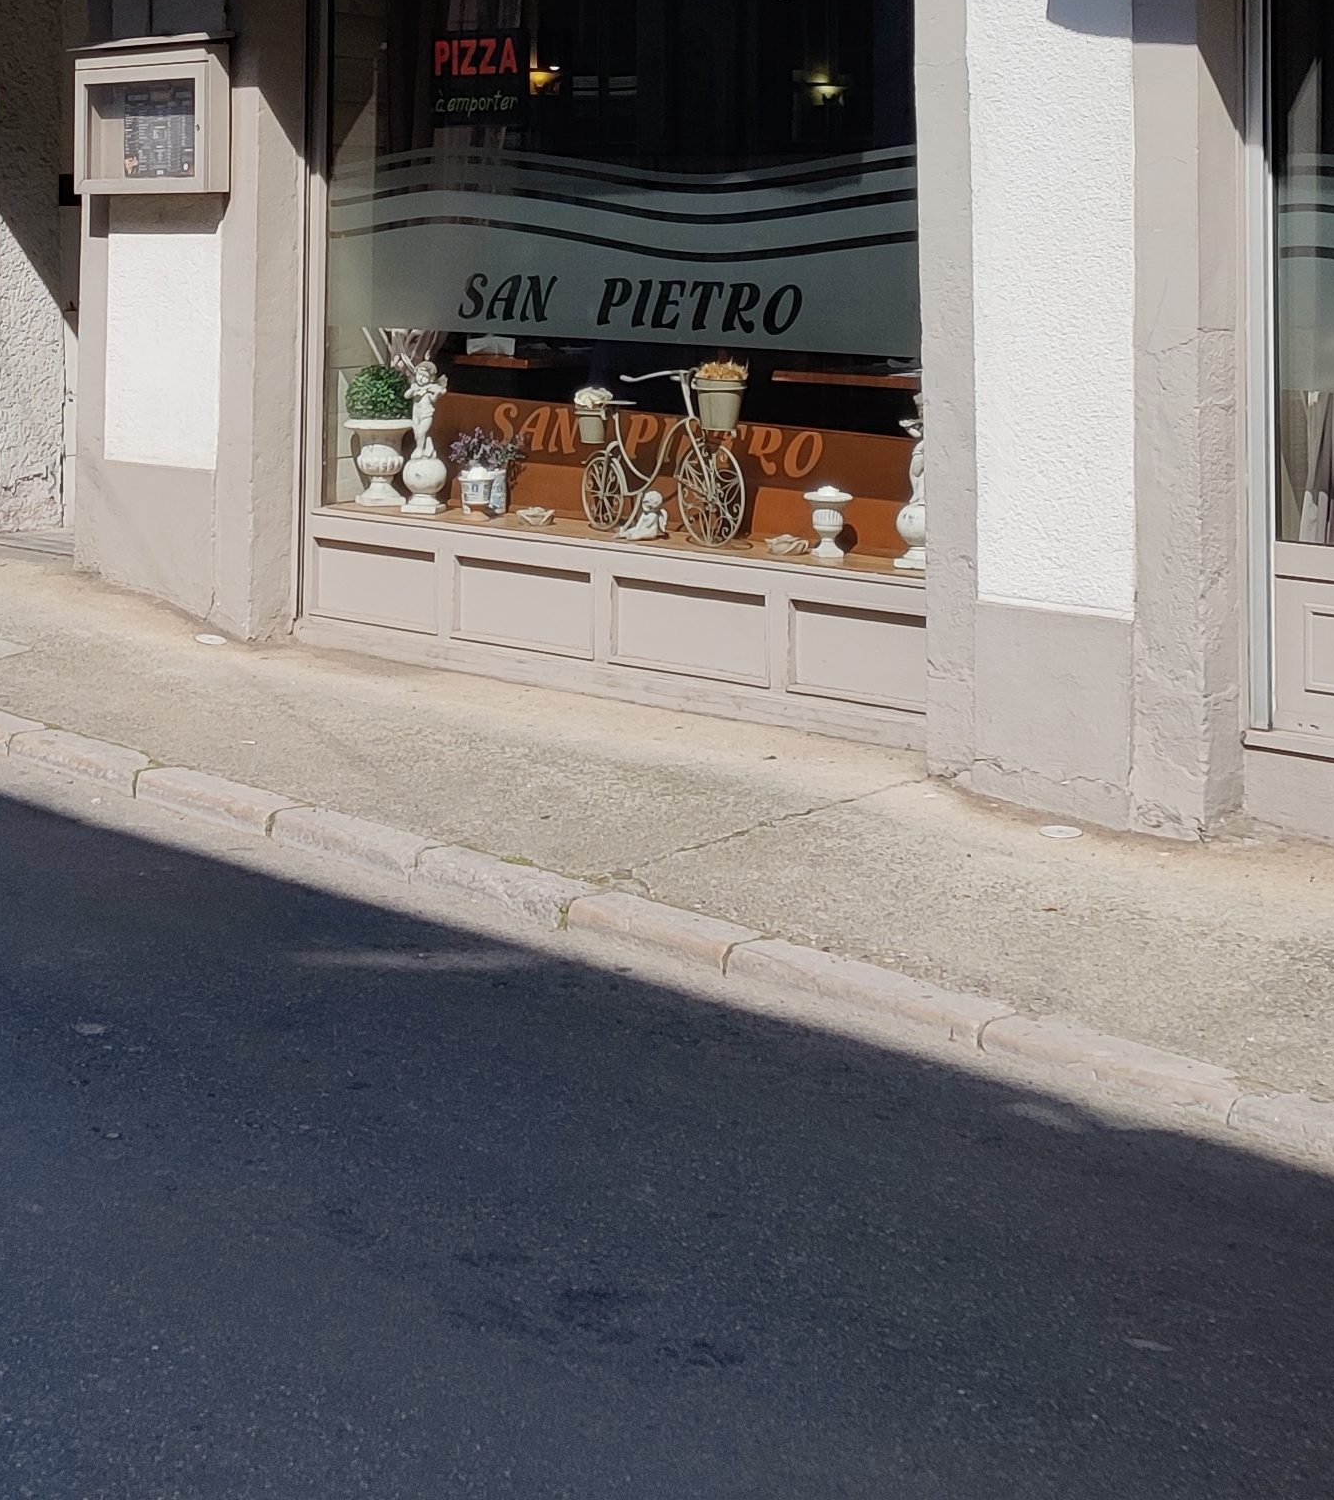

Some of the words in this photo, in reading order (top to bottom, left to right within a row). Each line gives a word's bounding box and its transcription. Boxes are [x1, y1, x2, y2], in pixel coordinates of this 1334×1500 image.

[434, 37, 518, 76] PIZZA
[435, 89, 446, 113] à
[447, 89, 518, 118] emporter
[459, 273, 558, 323] SAN
[596, 277, 803, 336] PIETRO
[493, 402, 579, 455] SAN
